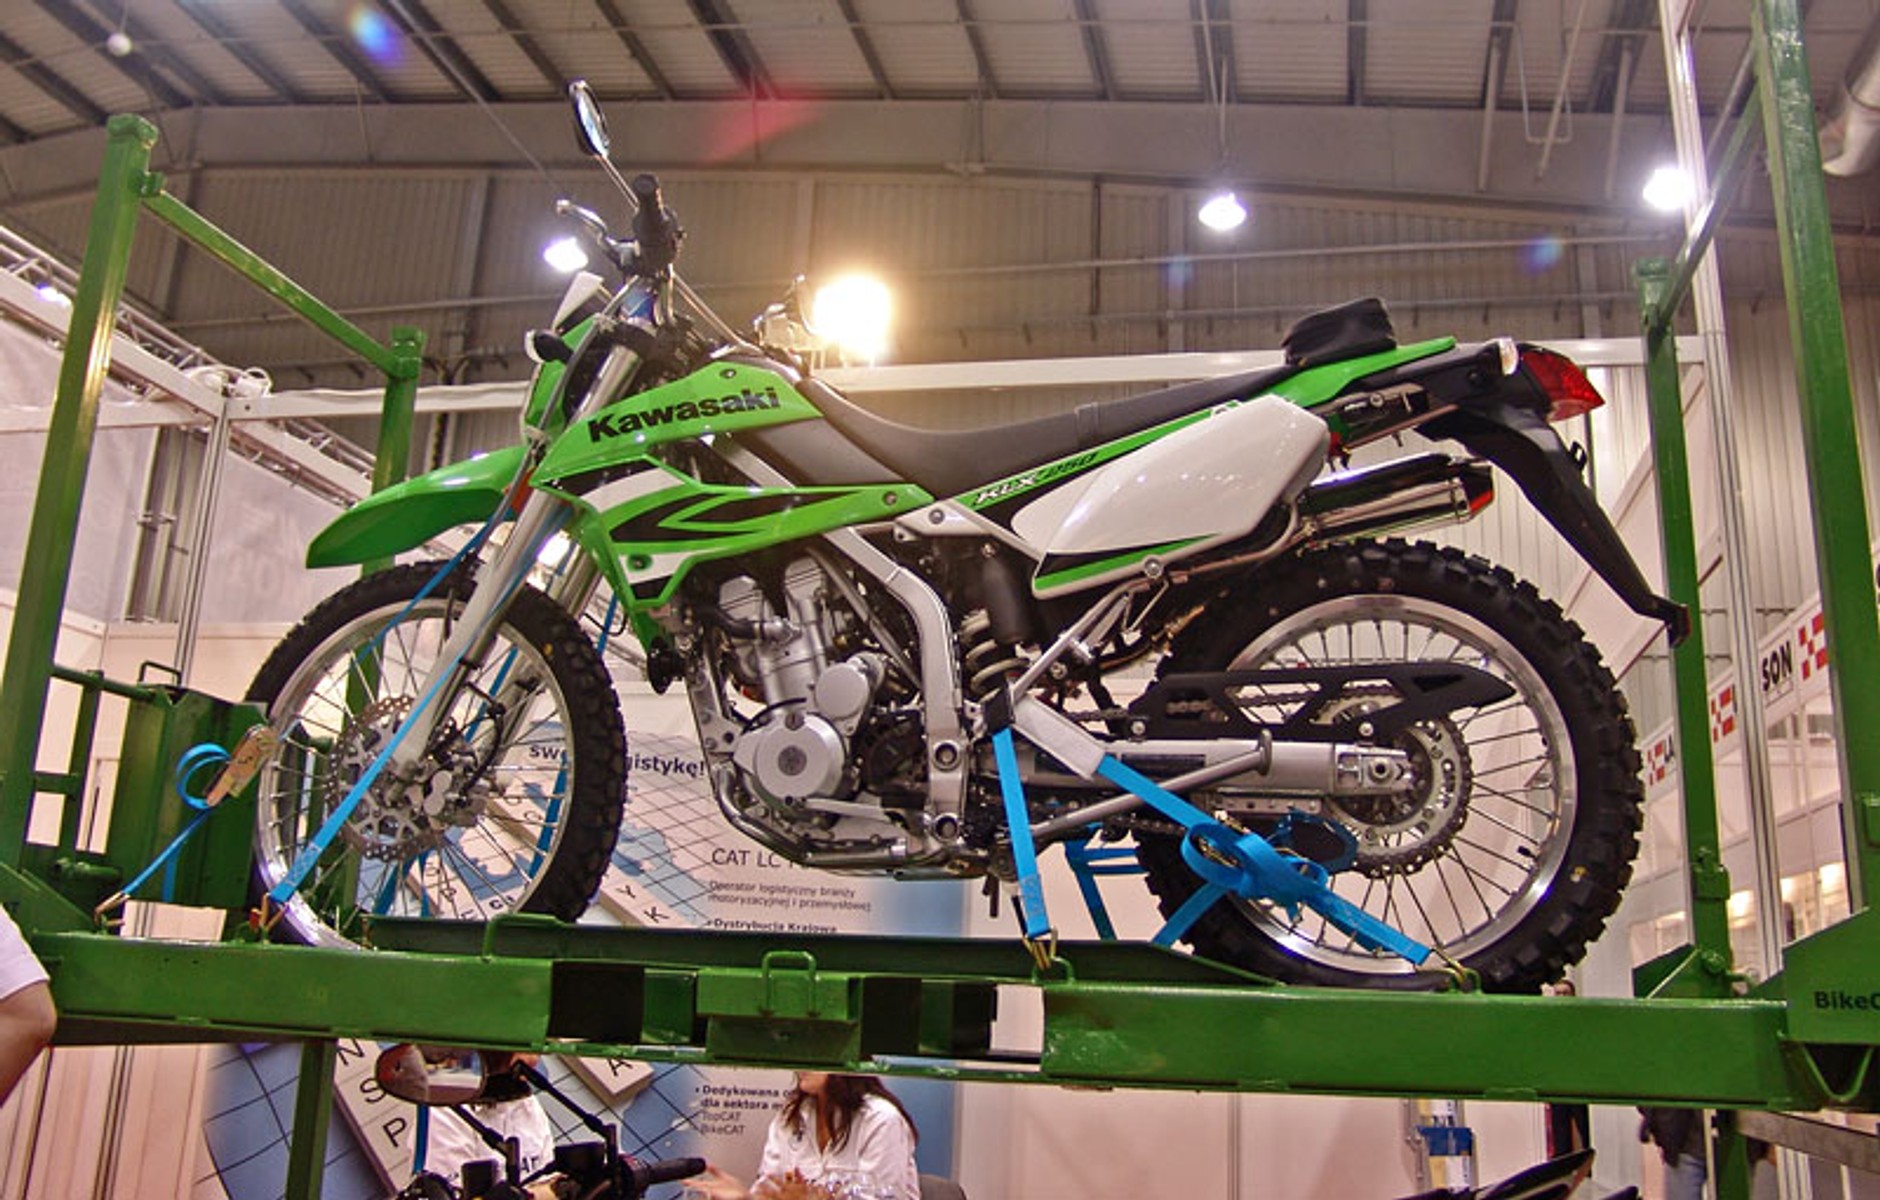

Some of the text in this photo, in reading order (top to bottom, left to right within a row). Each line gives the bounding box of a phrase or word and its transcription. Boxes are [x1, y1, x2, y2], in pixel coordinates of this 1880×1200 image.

[587, 386, 781, 443] Kawasaki
[1762, 640, 1792, 692] SON
[711, 847, 751, 866] CAT
[702, 1084, 780, 1098] Dedykowana
